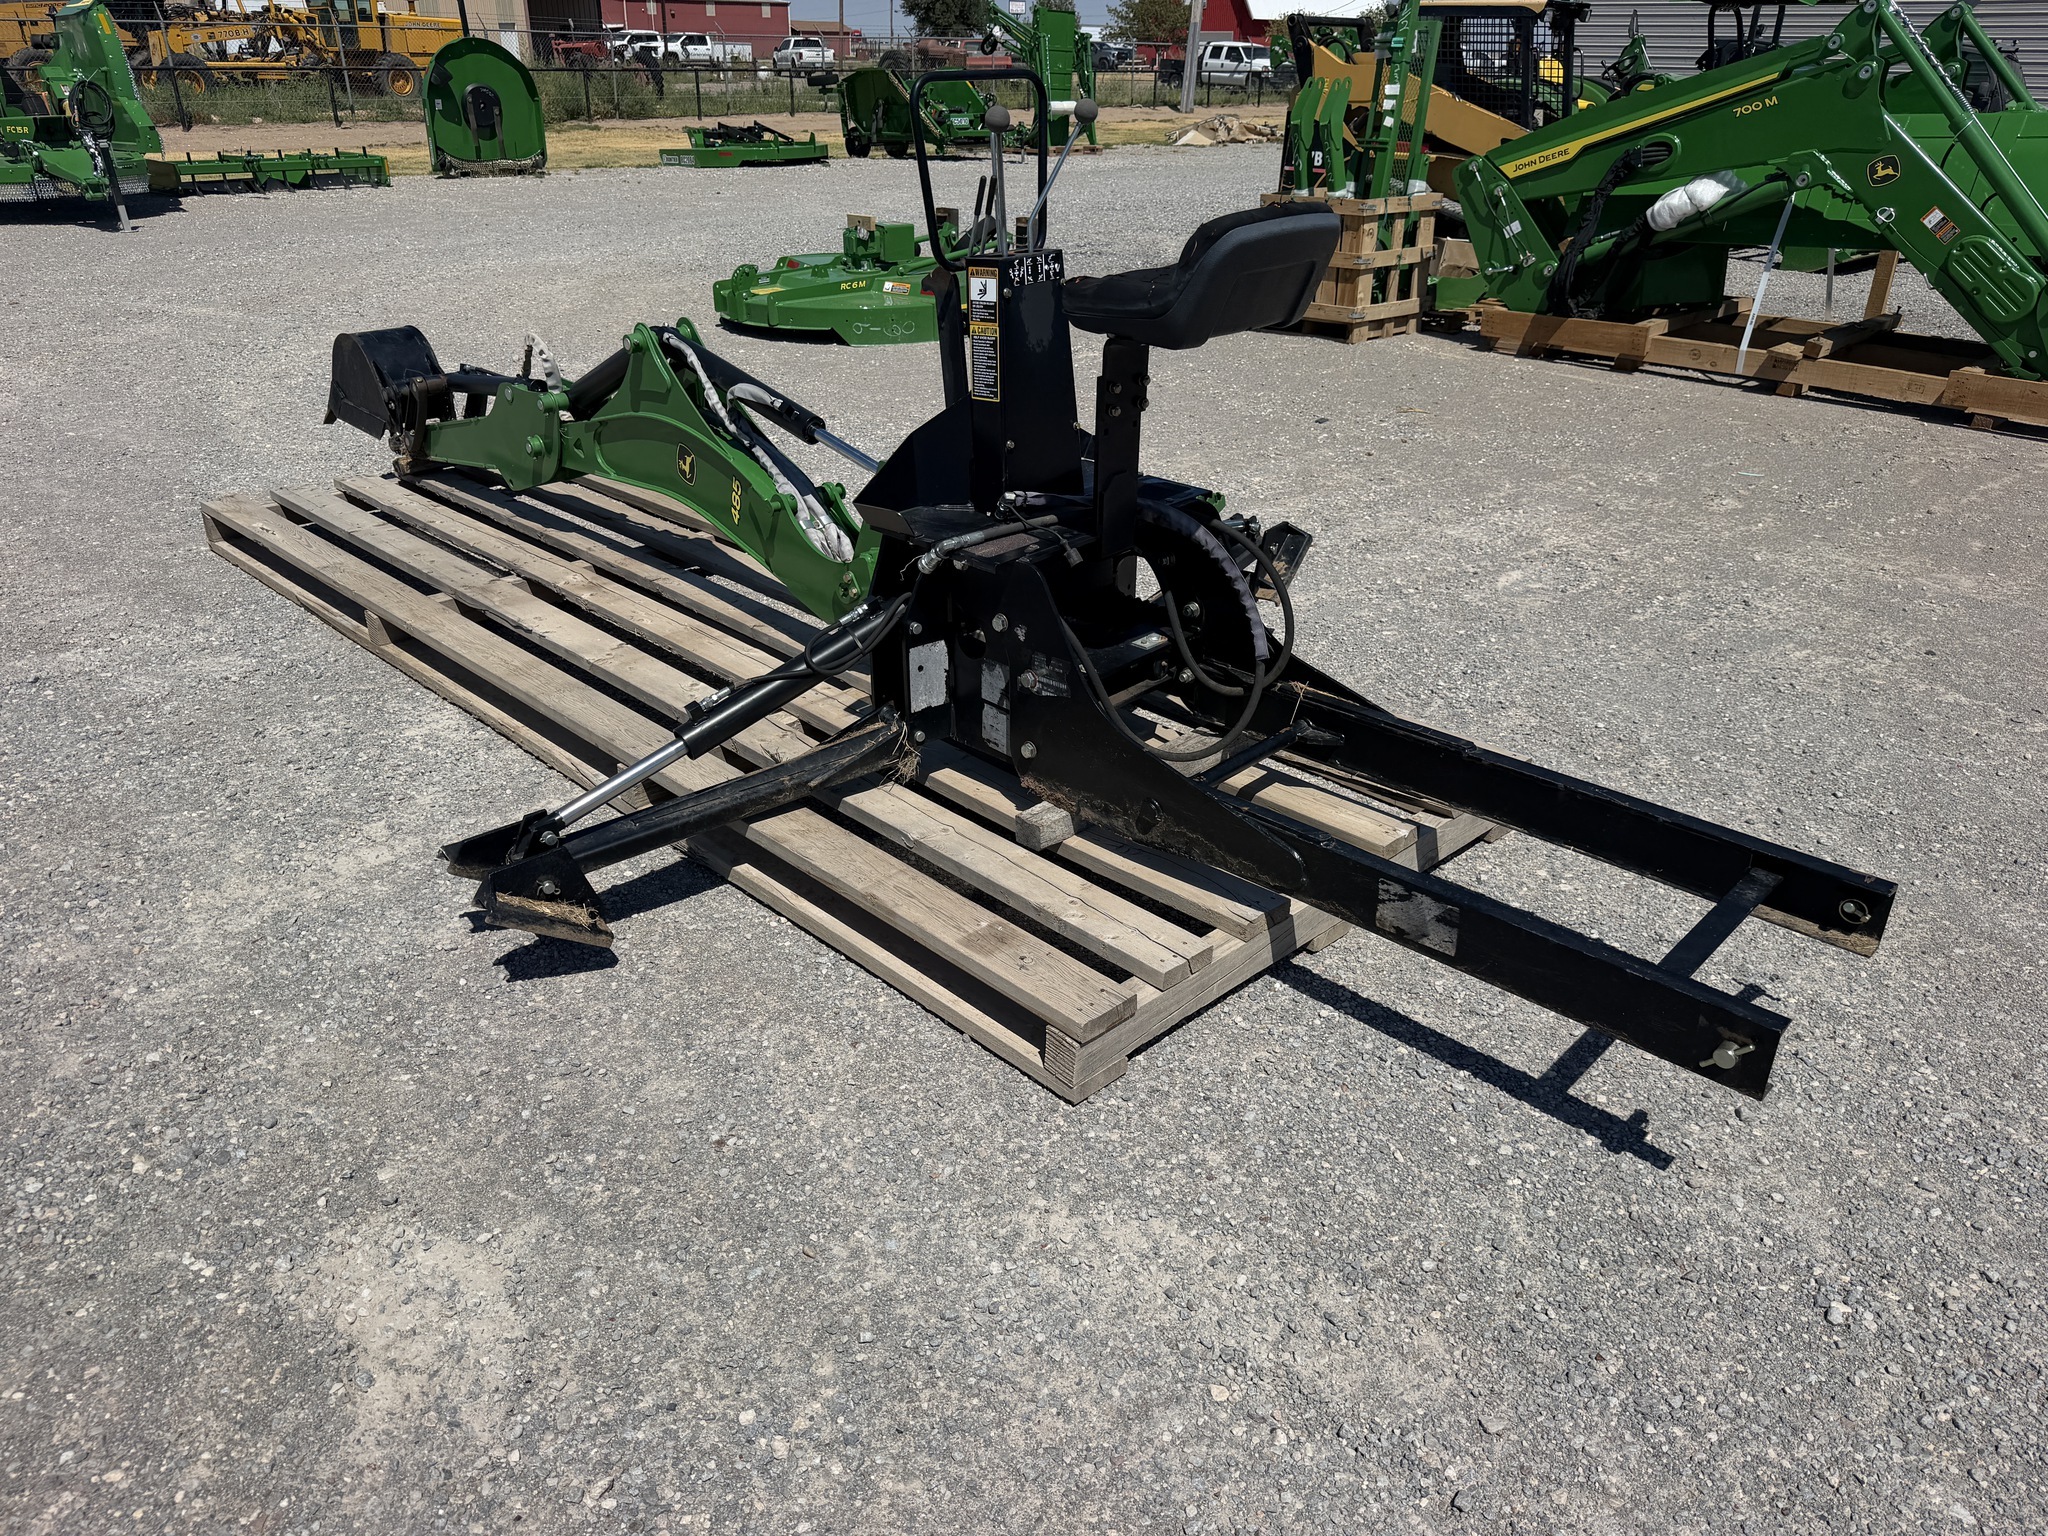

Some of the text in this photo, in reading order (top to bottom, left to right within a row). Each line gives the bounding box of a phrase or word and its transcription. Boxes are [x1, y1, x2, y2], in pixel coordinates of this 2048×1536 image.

[1732, 95, 1779, 118] 700 M
[1513, 147, 1570, 173] JOHN DEERE
[974, 268, 998, 278] WARNING
[976, 326, 998, 336] CAUTION
[731, 475, 742, 526] 485
